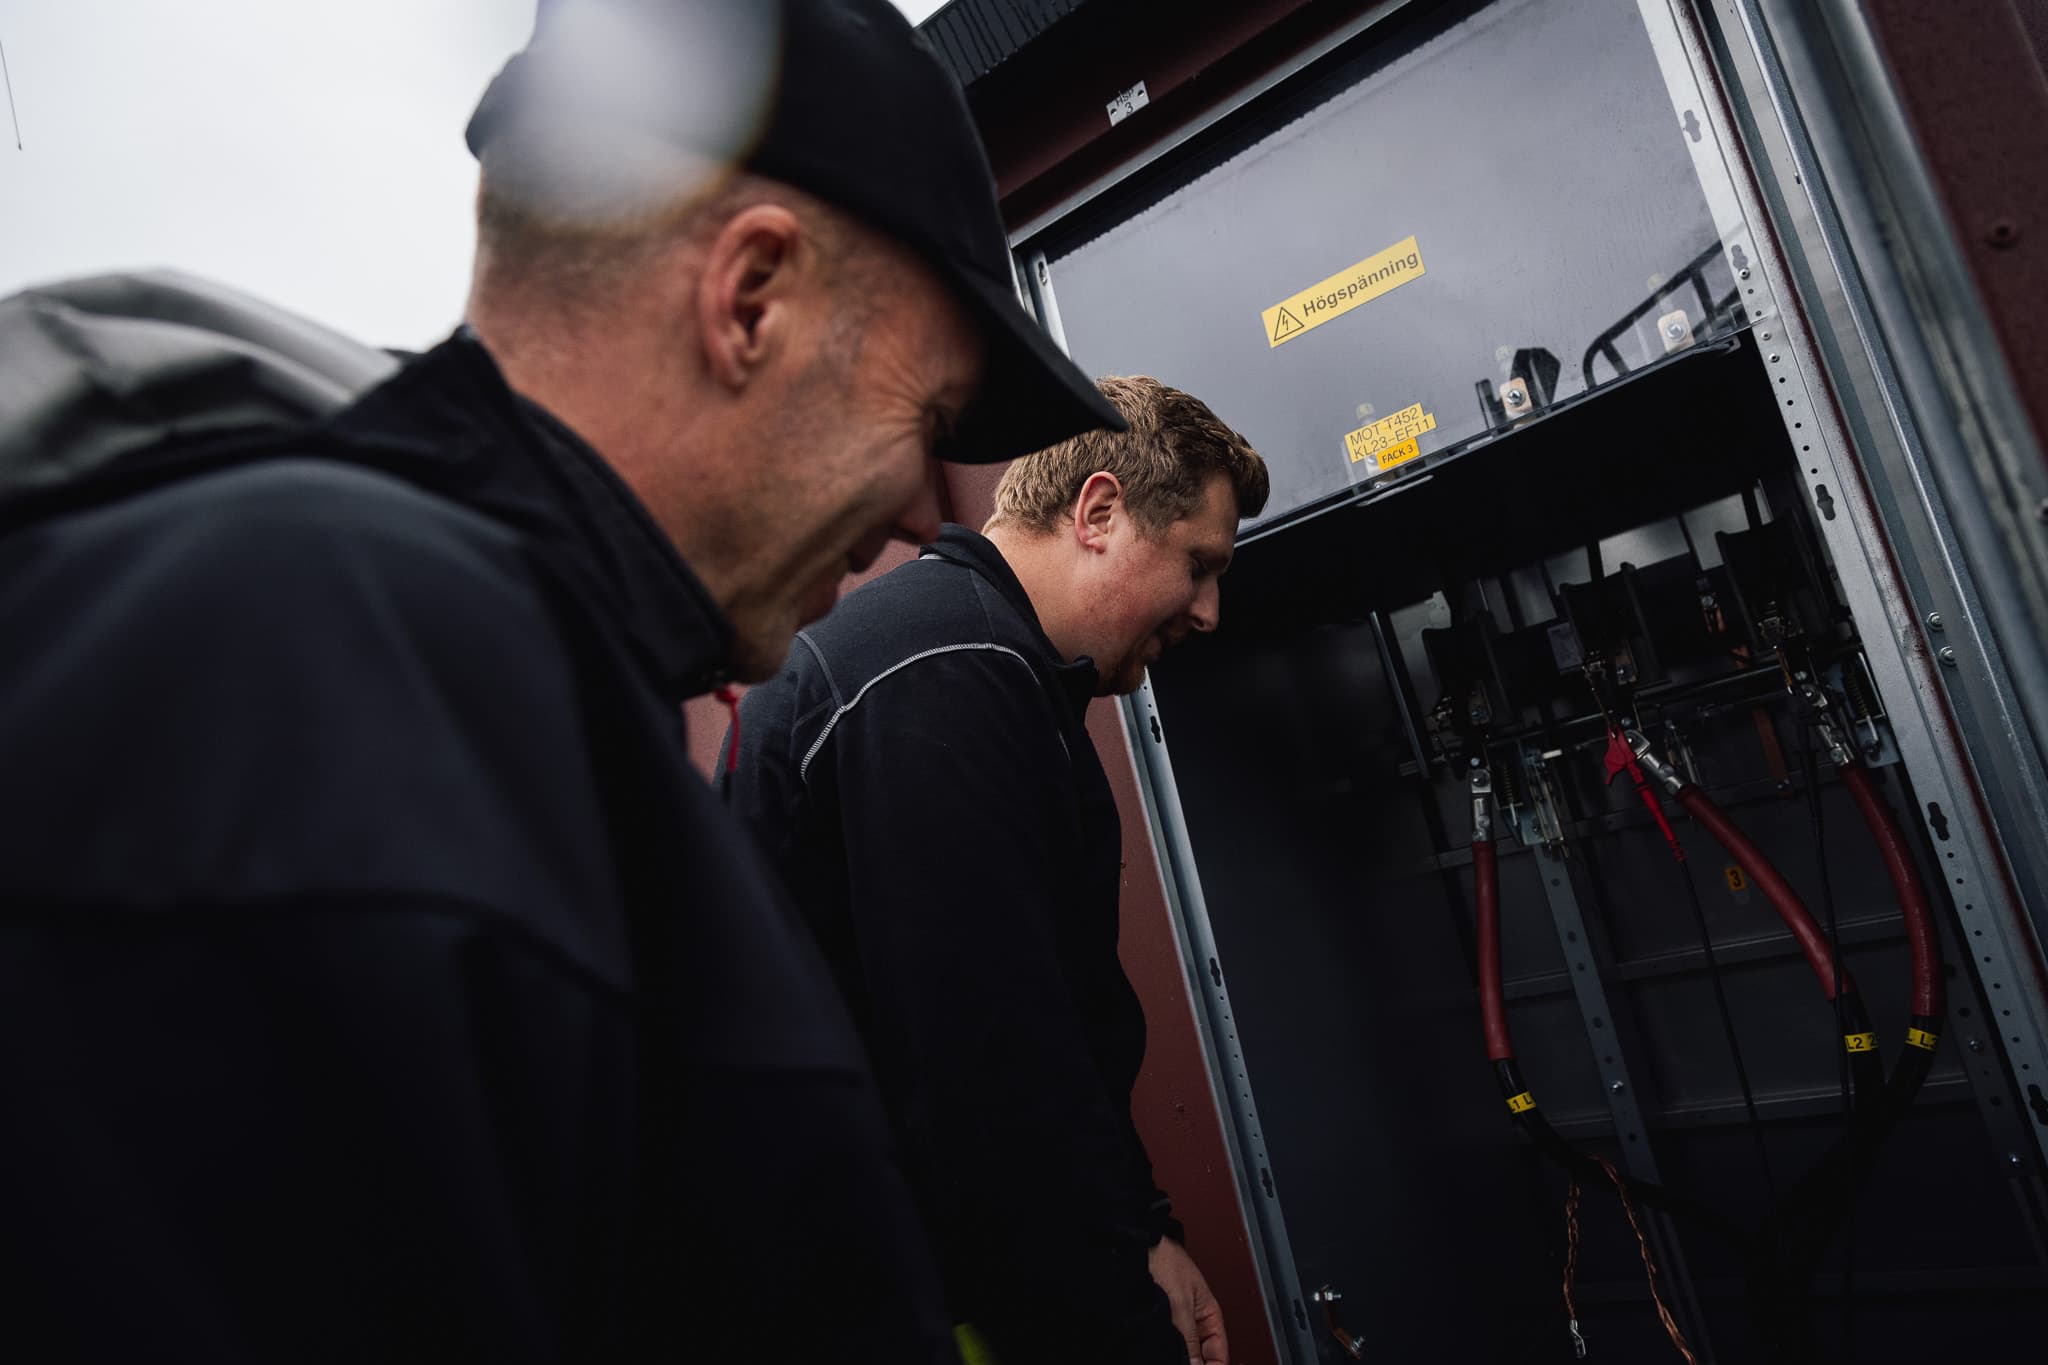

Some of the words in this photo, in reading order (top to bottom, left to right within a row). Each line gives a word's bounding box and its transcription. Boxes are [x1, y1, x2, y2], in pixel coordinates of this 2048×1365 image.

[1125, 101, 1134, 114] 3
[1302, 252, 1419, 318] Högspänning
[1350, 424, 1380, 446] MOT
[1384, 407, 1420, 430] T452
[1353, 418, 1430, 459] KL23-EF11
[1381, 448, 1406, 464] FACK
[1407, 443, 1414, 454] 3
[1729, 869, 1742, 888] 3
[1846, 1037, 1865, 1050] L2
